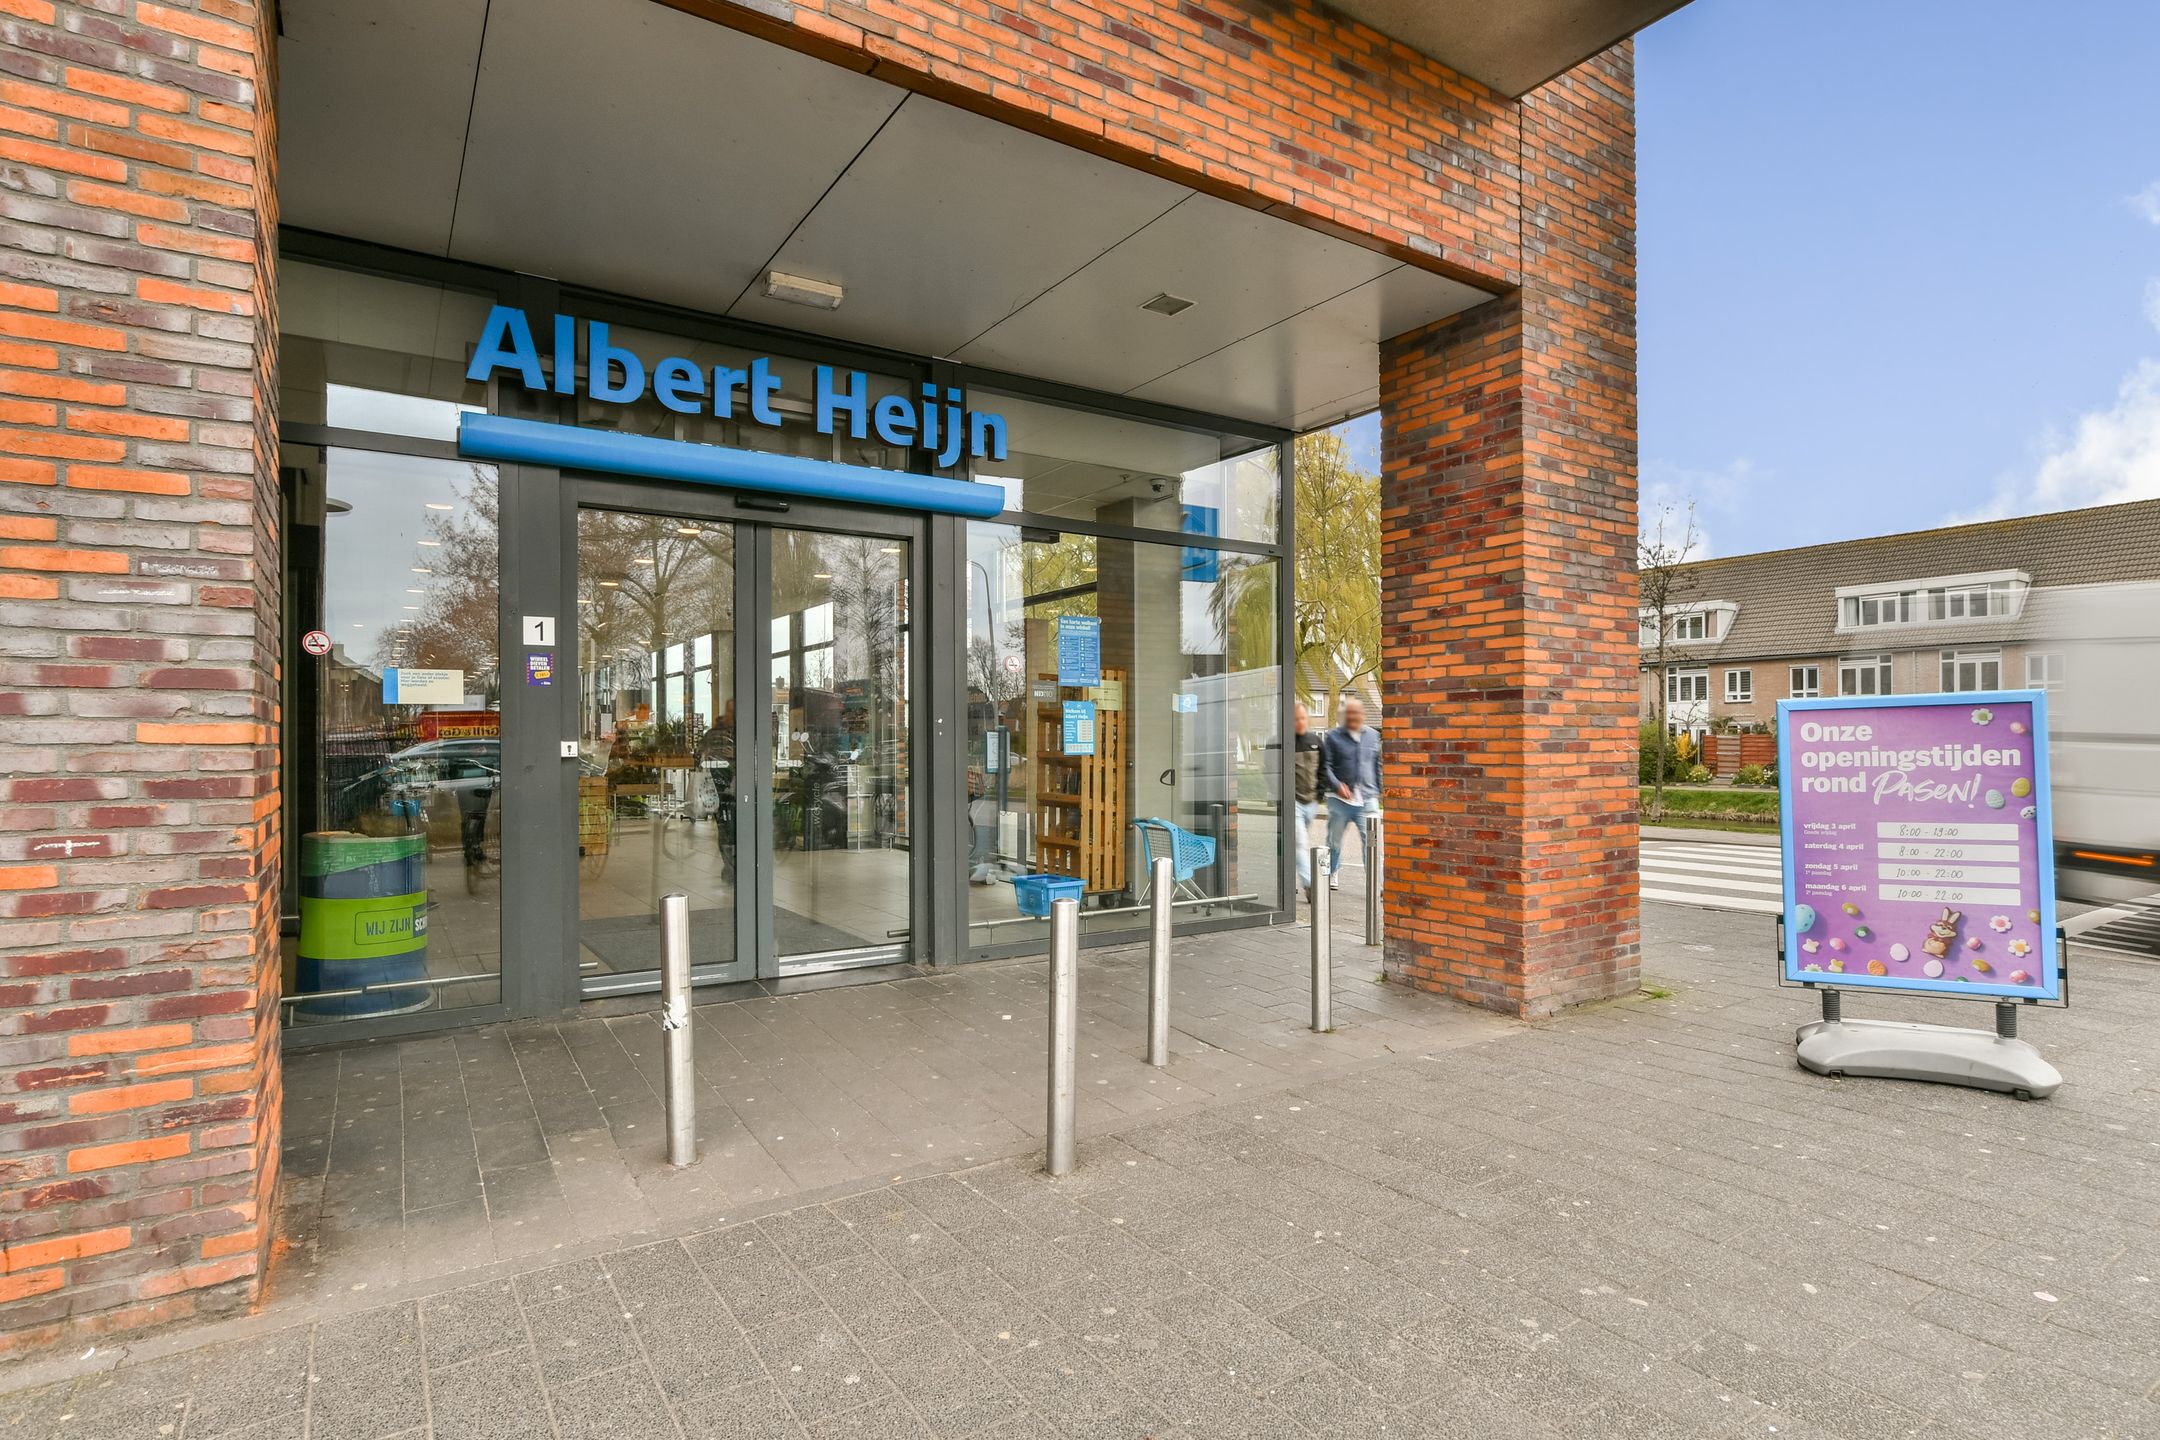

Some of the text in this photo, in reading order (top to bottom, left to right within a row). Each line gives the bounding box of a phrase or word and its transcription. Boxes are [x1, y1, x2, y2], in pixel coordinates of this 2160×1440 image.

[465, 304, 1008, 468] Albert Heijn
[534, 621, 544, 642] 1
[1800, 722, 1873, 742] Onze
[1801, 744, 2021, 772] openingstijden
[1802, 772, 1866, 793] rond
[812, 782, 824, 825] wecycle
[1804, 822, 1830, 830] vrijdag
[1899, 824, 1920, 837] 8:00
[1934, 848, 1963, 859] 22:00
[366, 920, 385, 936] WIJ
[390, 917, 411, 933] ZIJN
